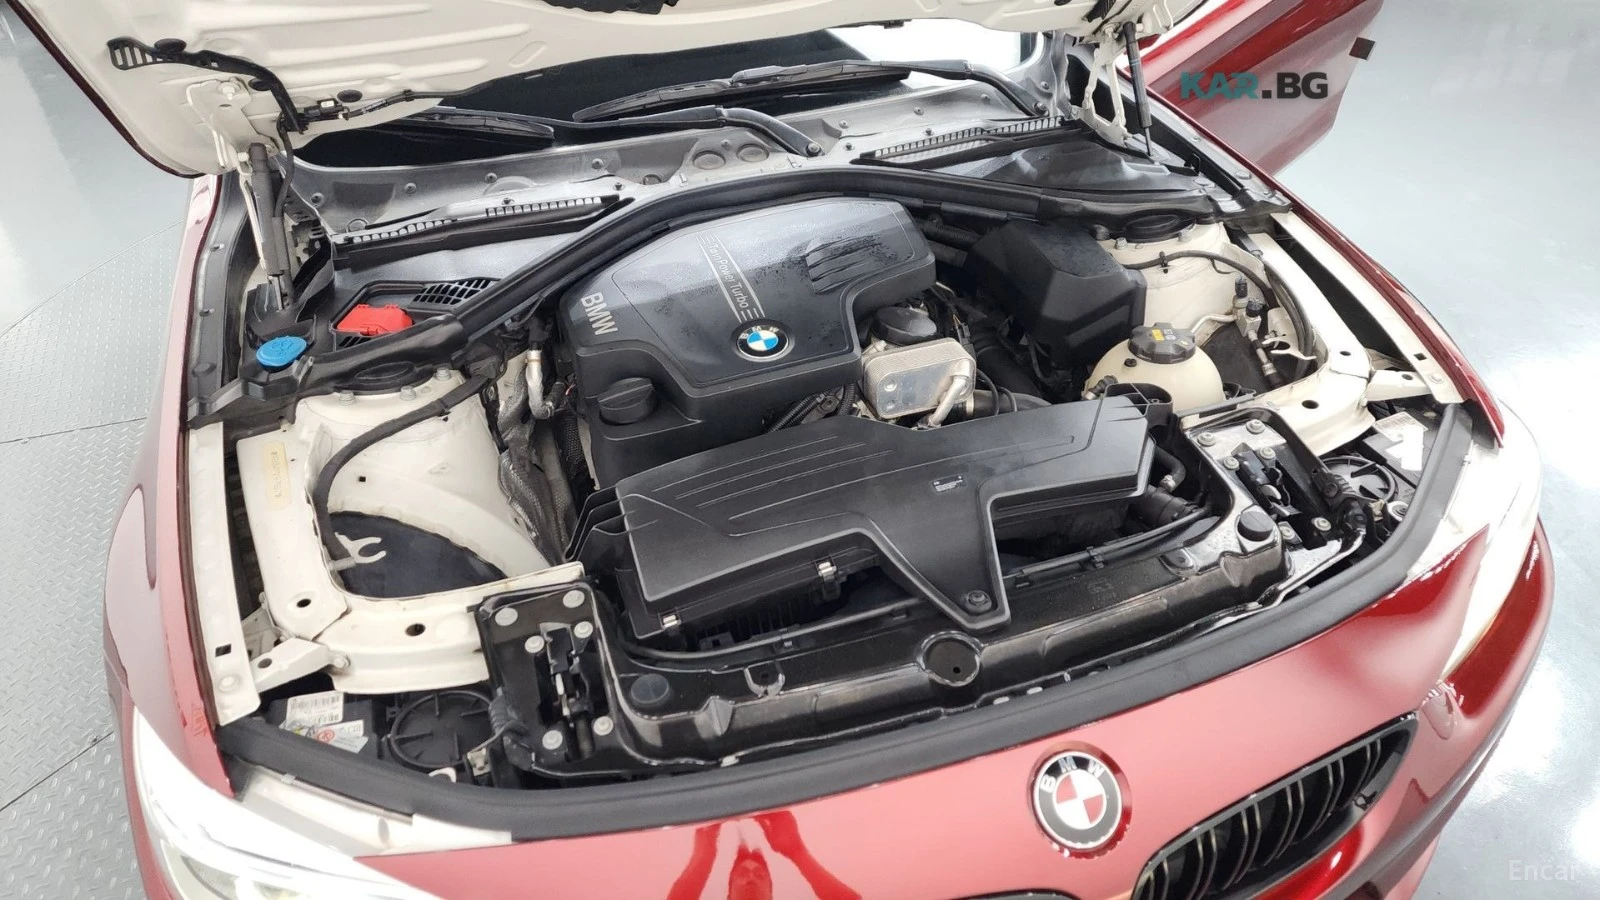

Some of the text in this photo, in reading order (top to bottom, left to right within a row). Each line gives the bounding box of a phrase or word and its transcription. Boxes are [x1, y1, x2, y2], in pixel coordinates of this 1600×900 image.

[708, 242, 749, 309] TwinPower Turbo
[580, 291, 619, 336] BMW
[738, 325, 780, 340] BMW
[1039, 755, 1106, 793] BMW
